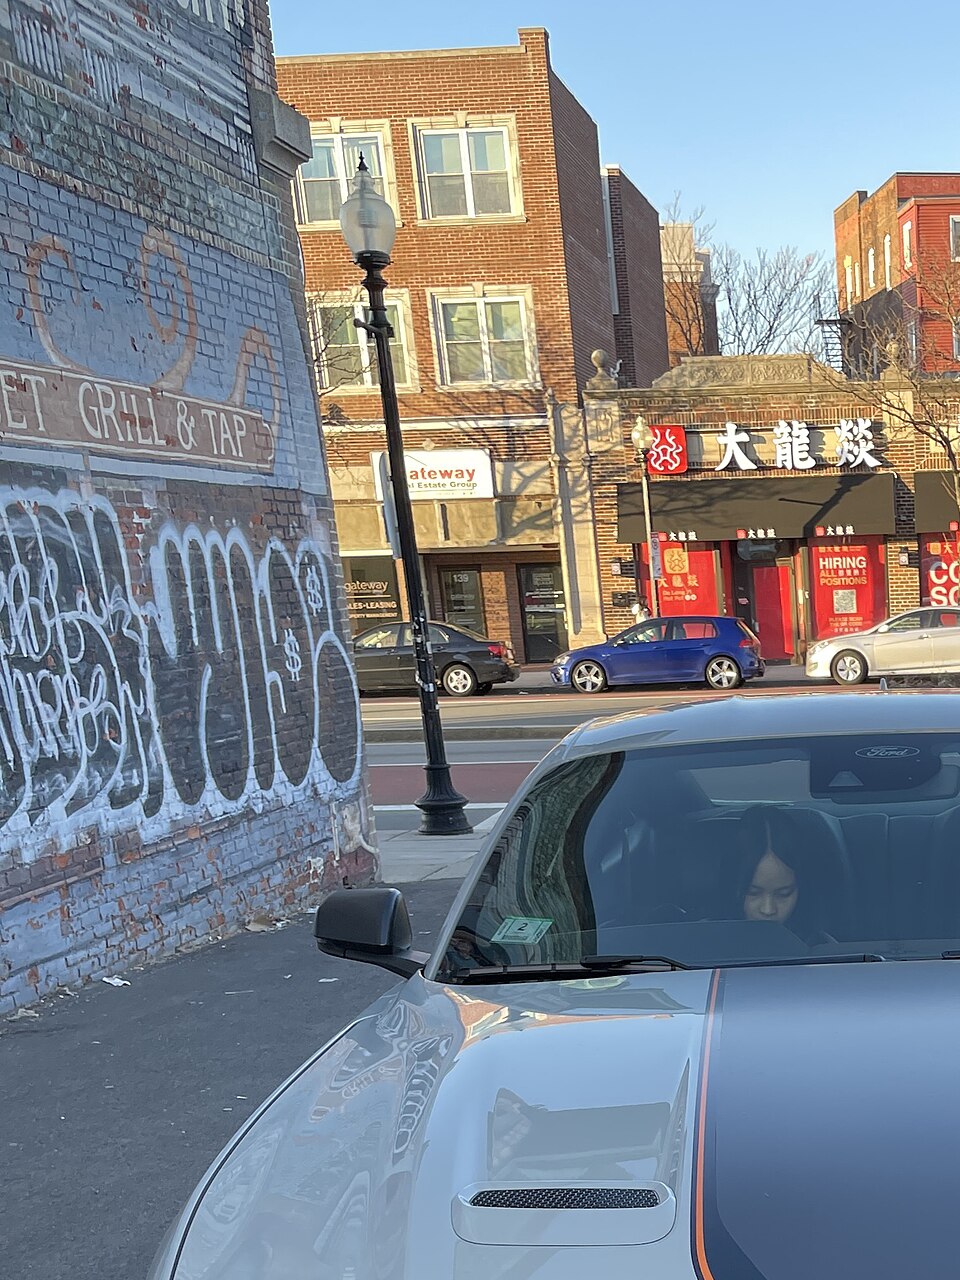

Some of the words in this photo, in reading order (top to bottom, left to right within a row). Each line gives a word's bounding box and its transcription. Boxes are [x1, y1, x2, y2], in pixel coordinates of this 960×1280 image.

[78, 381, 168, 447] GRILL
[176, 400, 198, 450] &
[200, 408, 247, 458] TAP
[714, 417, 883, 471] 大龍燚
[409, 467, 476, 482] ateway
[449, 481, 478, 490] Group
[819, 556, 867, 570] HIRING
[453, 574, 469, 583] 139
[820, 569, 837, 578] ALL
[344, 580, 388, 593] gateway
[820, 577, 867, 586] POSITIONS
[866, 747, 908, 757] Ford
[517, 922, 529, 932] 2
